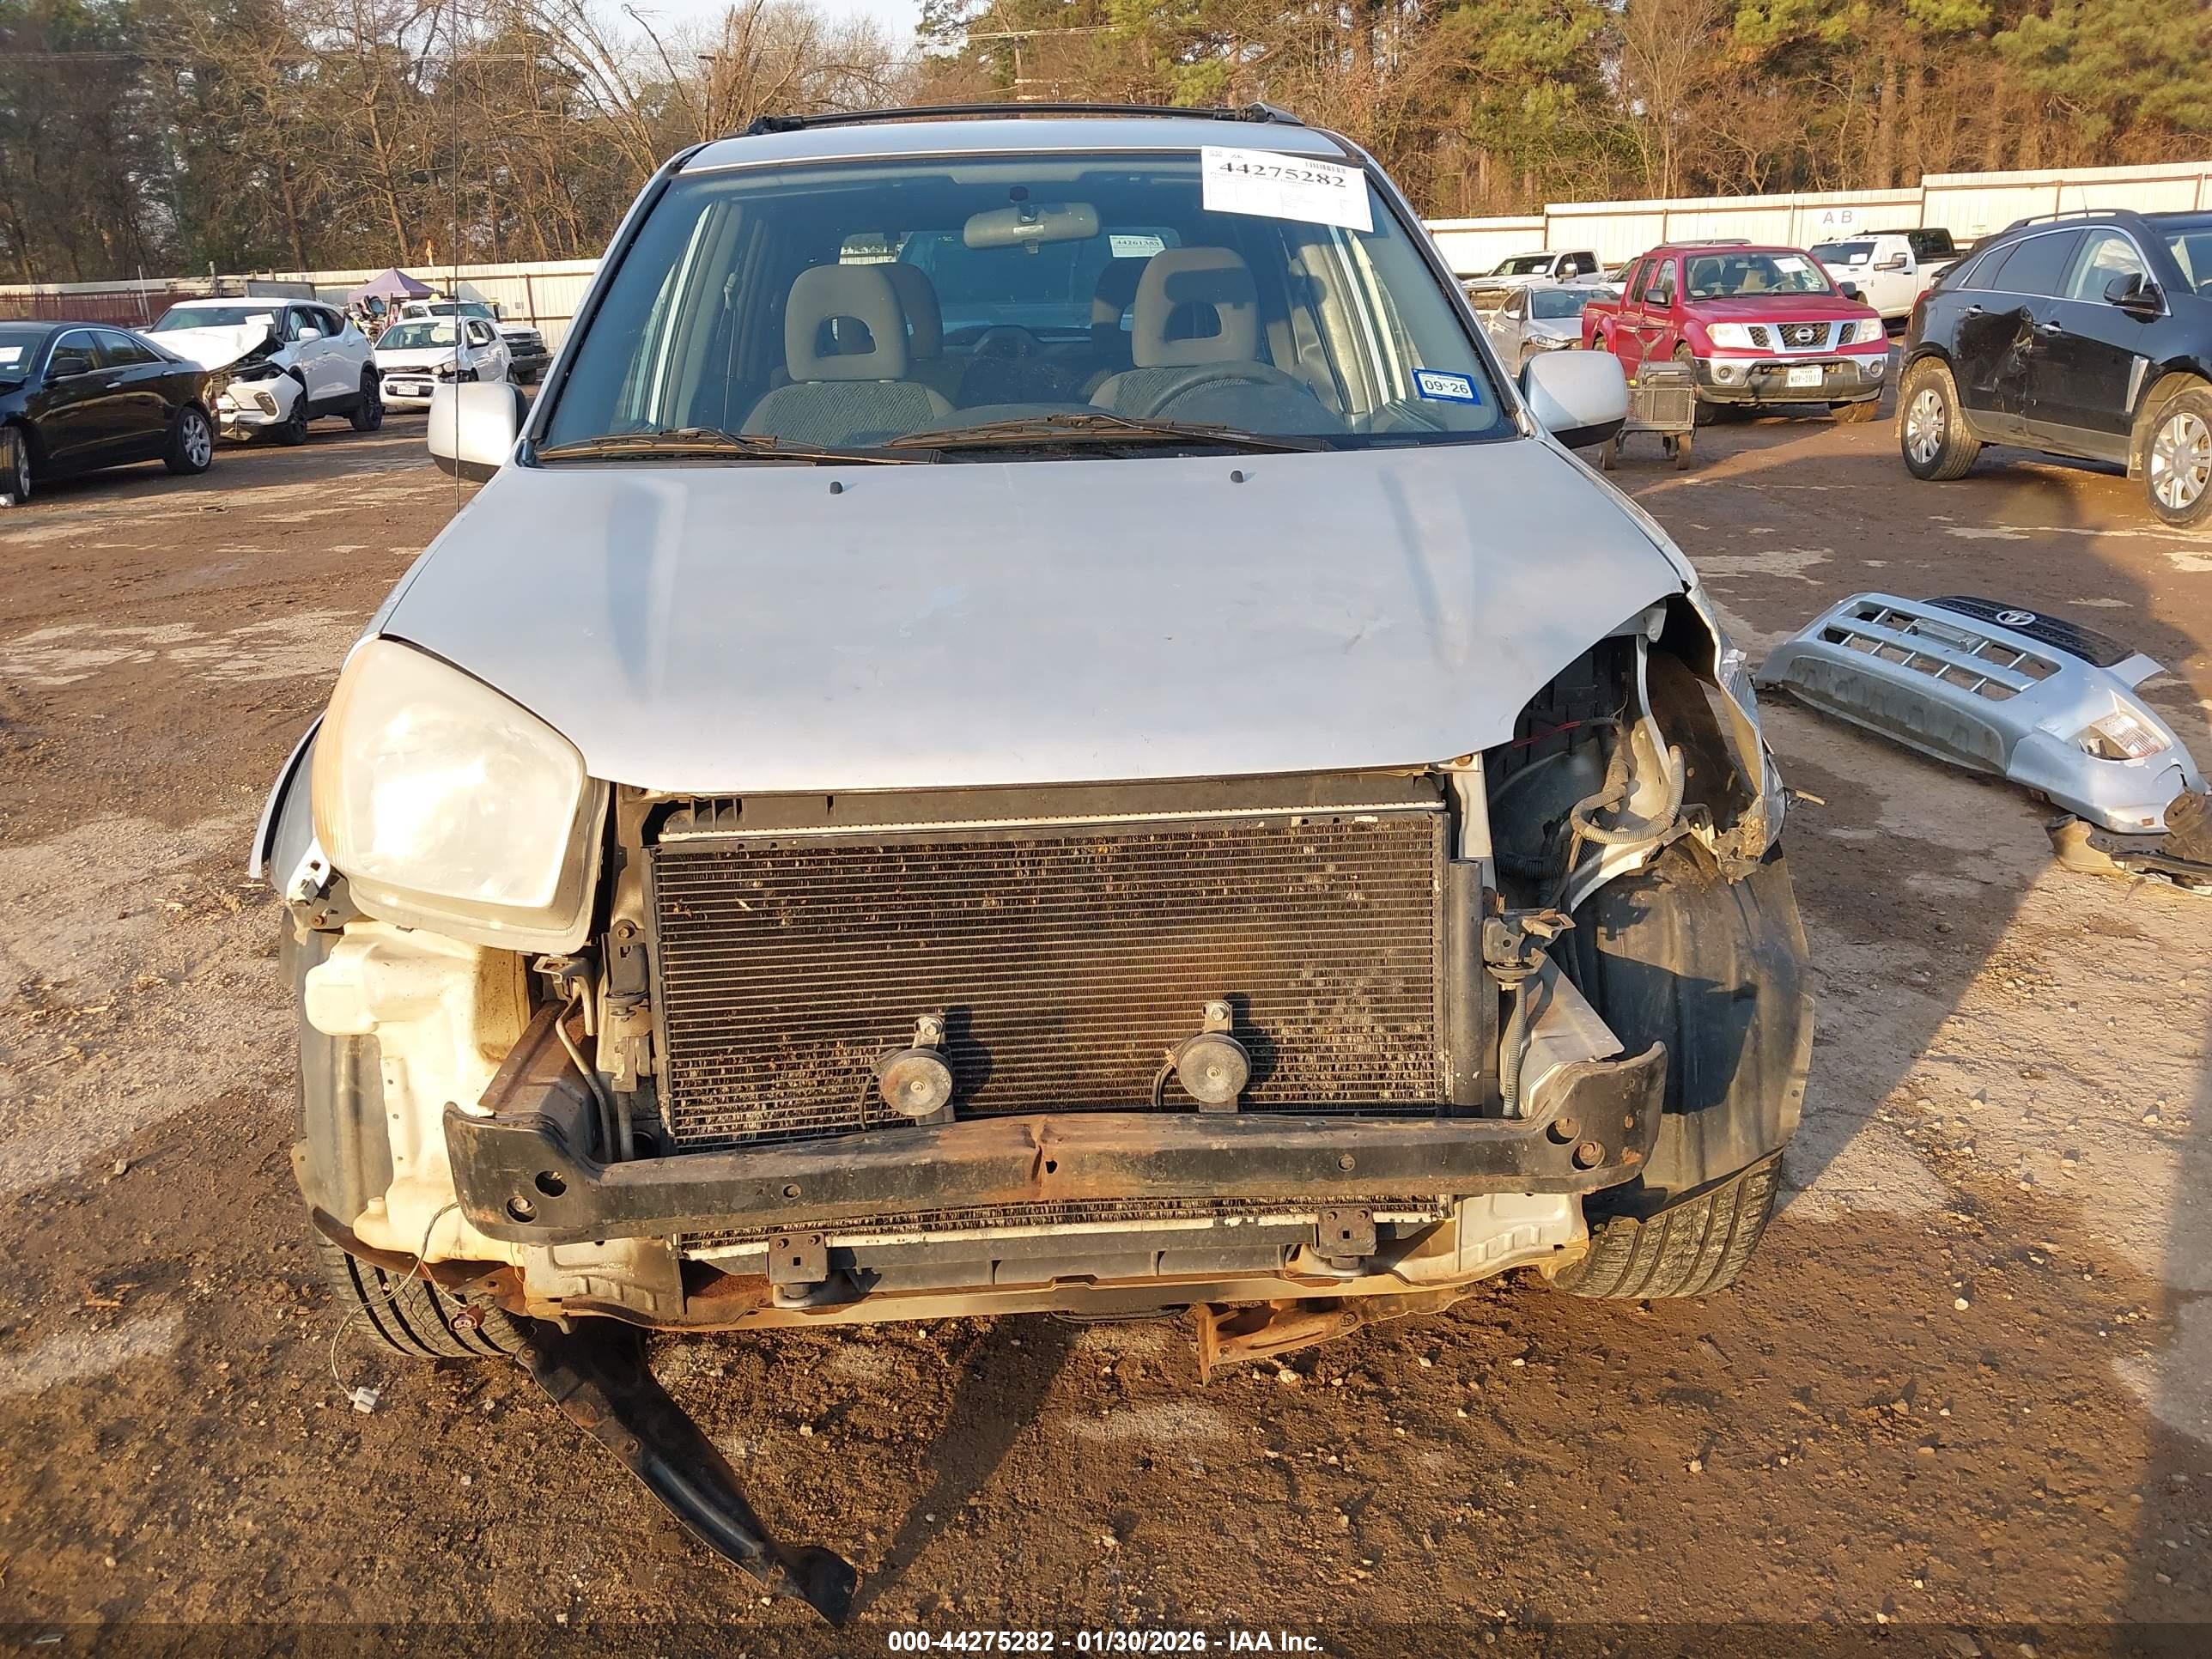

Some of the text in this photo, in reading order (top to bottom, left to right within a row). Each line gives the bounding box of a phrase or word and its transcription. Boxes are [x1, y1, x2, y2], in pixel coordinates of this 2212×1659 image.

[1219, 161, 1346, 188] 44275282
[1425, 380, 1469, 394] 09 26
